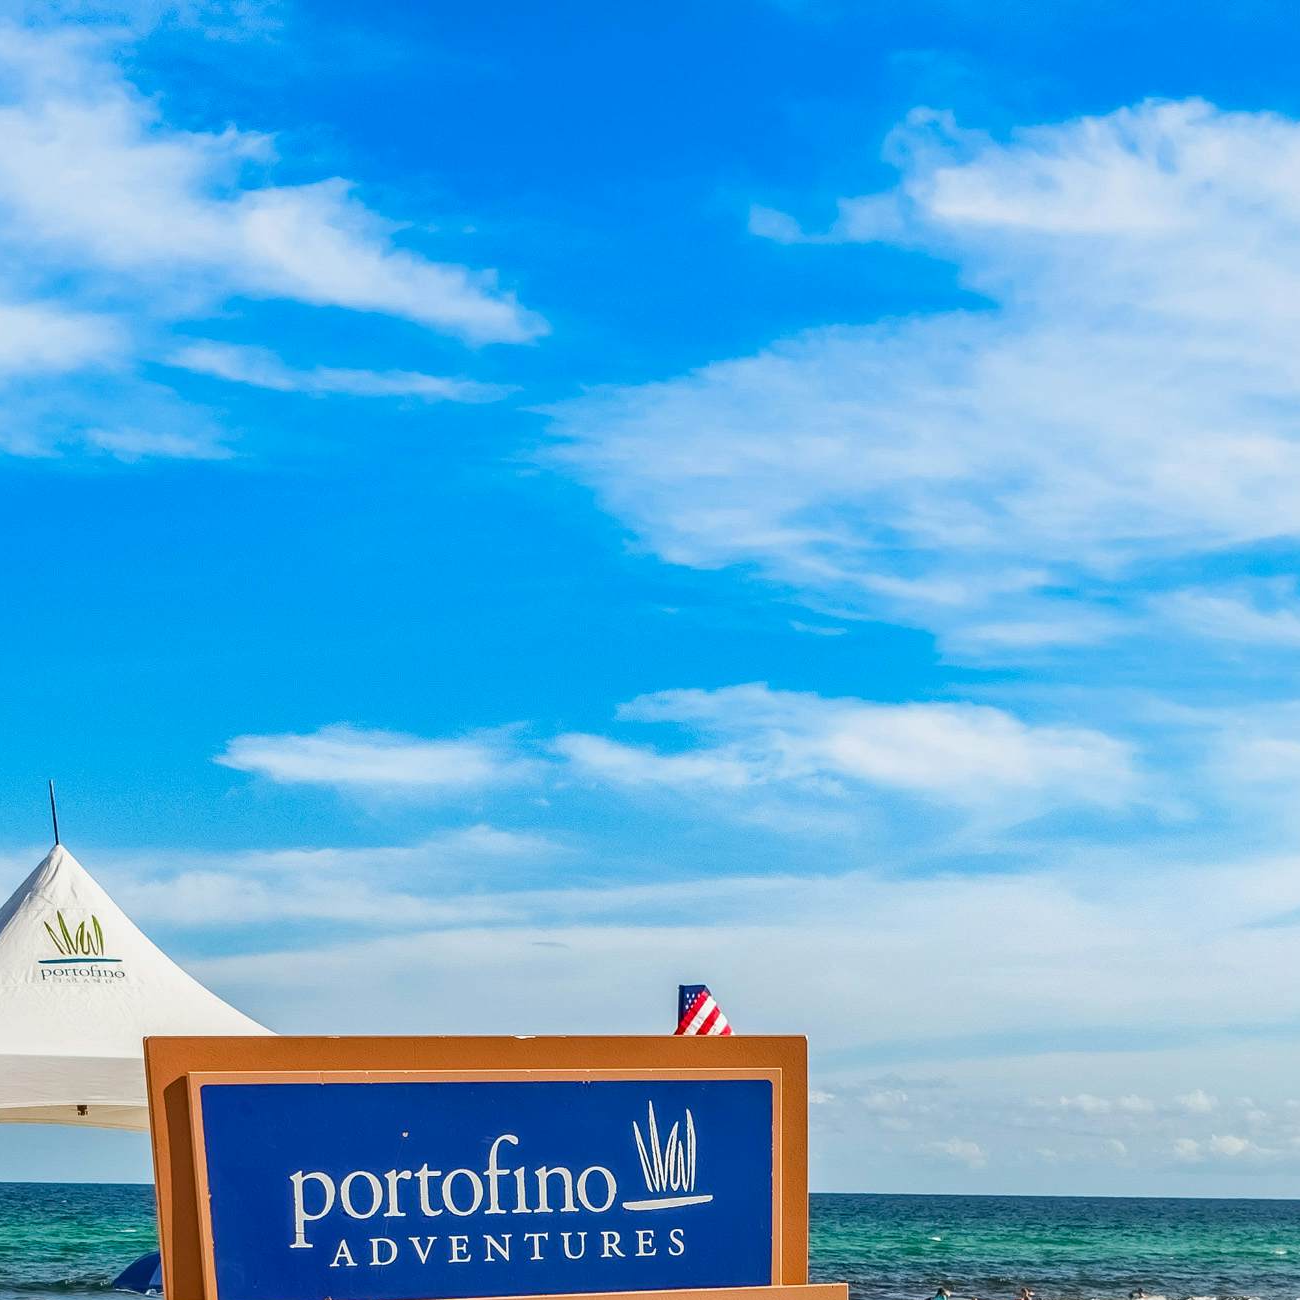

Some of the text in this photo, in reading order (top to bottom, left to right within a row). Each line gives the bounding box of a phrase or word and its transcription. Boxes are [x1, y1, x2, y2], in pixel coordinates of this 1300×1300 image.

[41, 965, 126, 981] portofino
[289, 1134, 618, 1249] portofino
[330, 1228, 686, 1268] ADVENTURES
